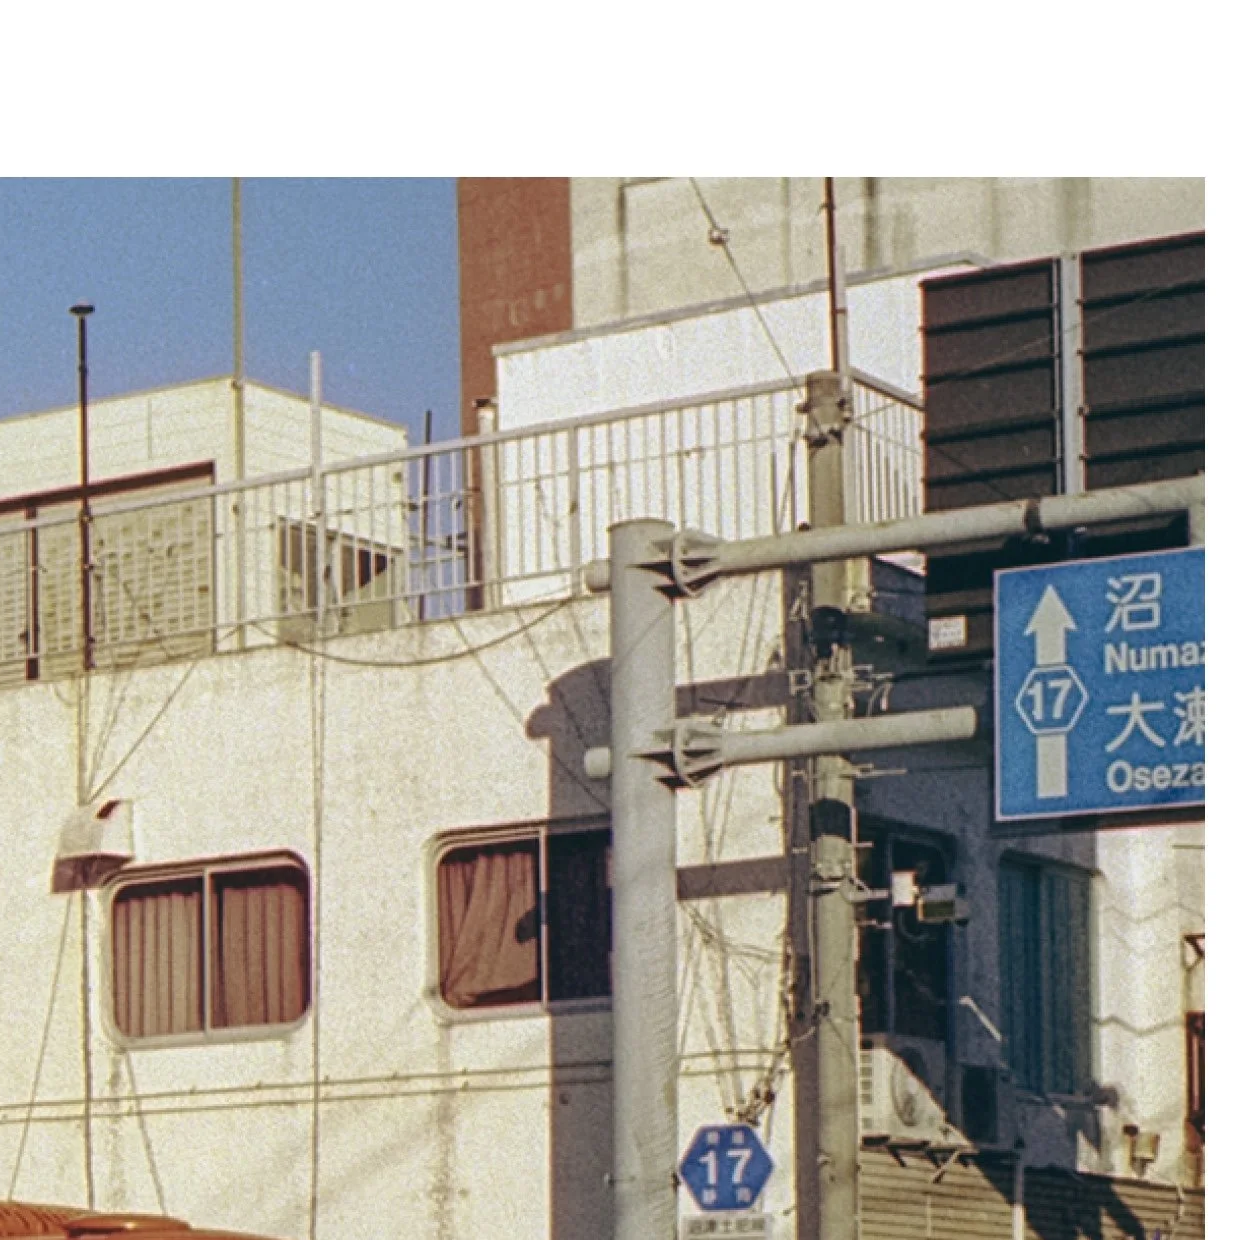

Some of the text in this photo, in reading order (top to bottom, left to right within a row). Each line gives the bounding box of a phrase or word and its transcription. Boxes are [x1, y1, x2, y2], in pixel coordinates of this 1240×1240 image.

[1105, 572, 1161, 632] 沼
[1027, 678, 1073, 721] 17
[698, 1148, 753, 1186] 17
